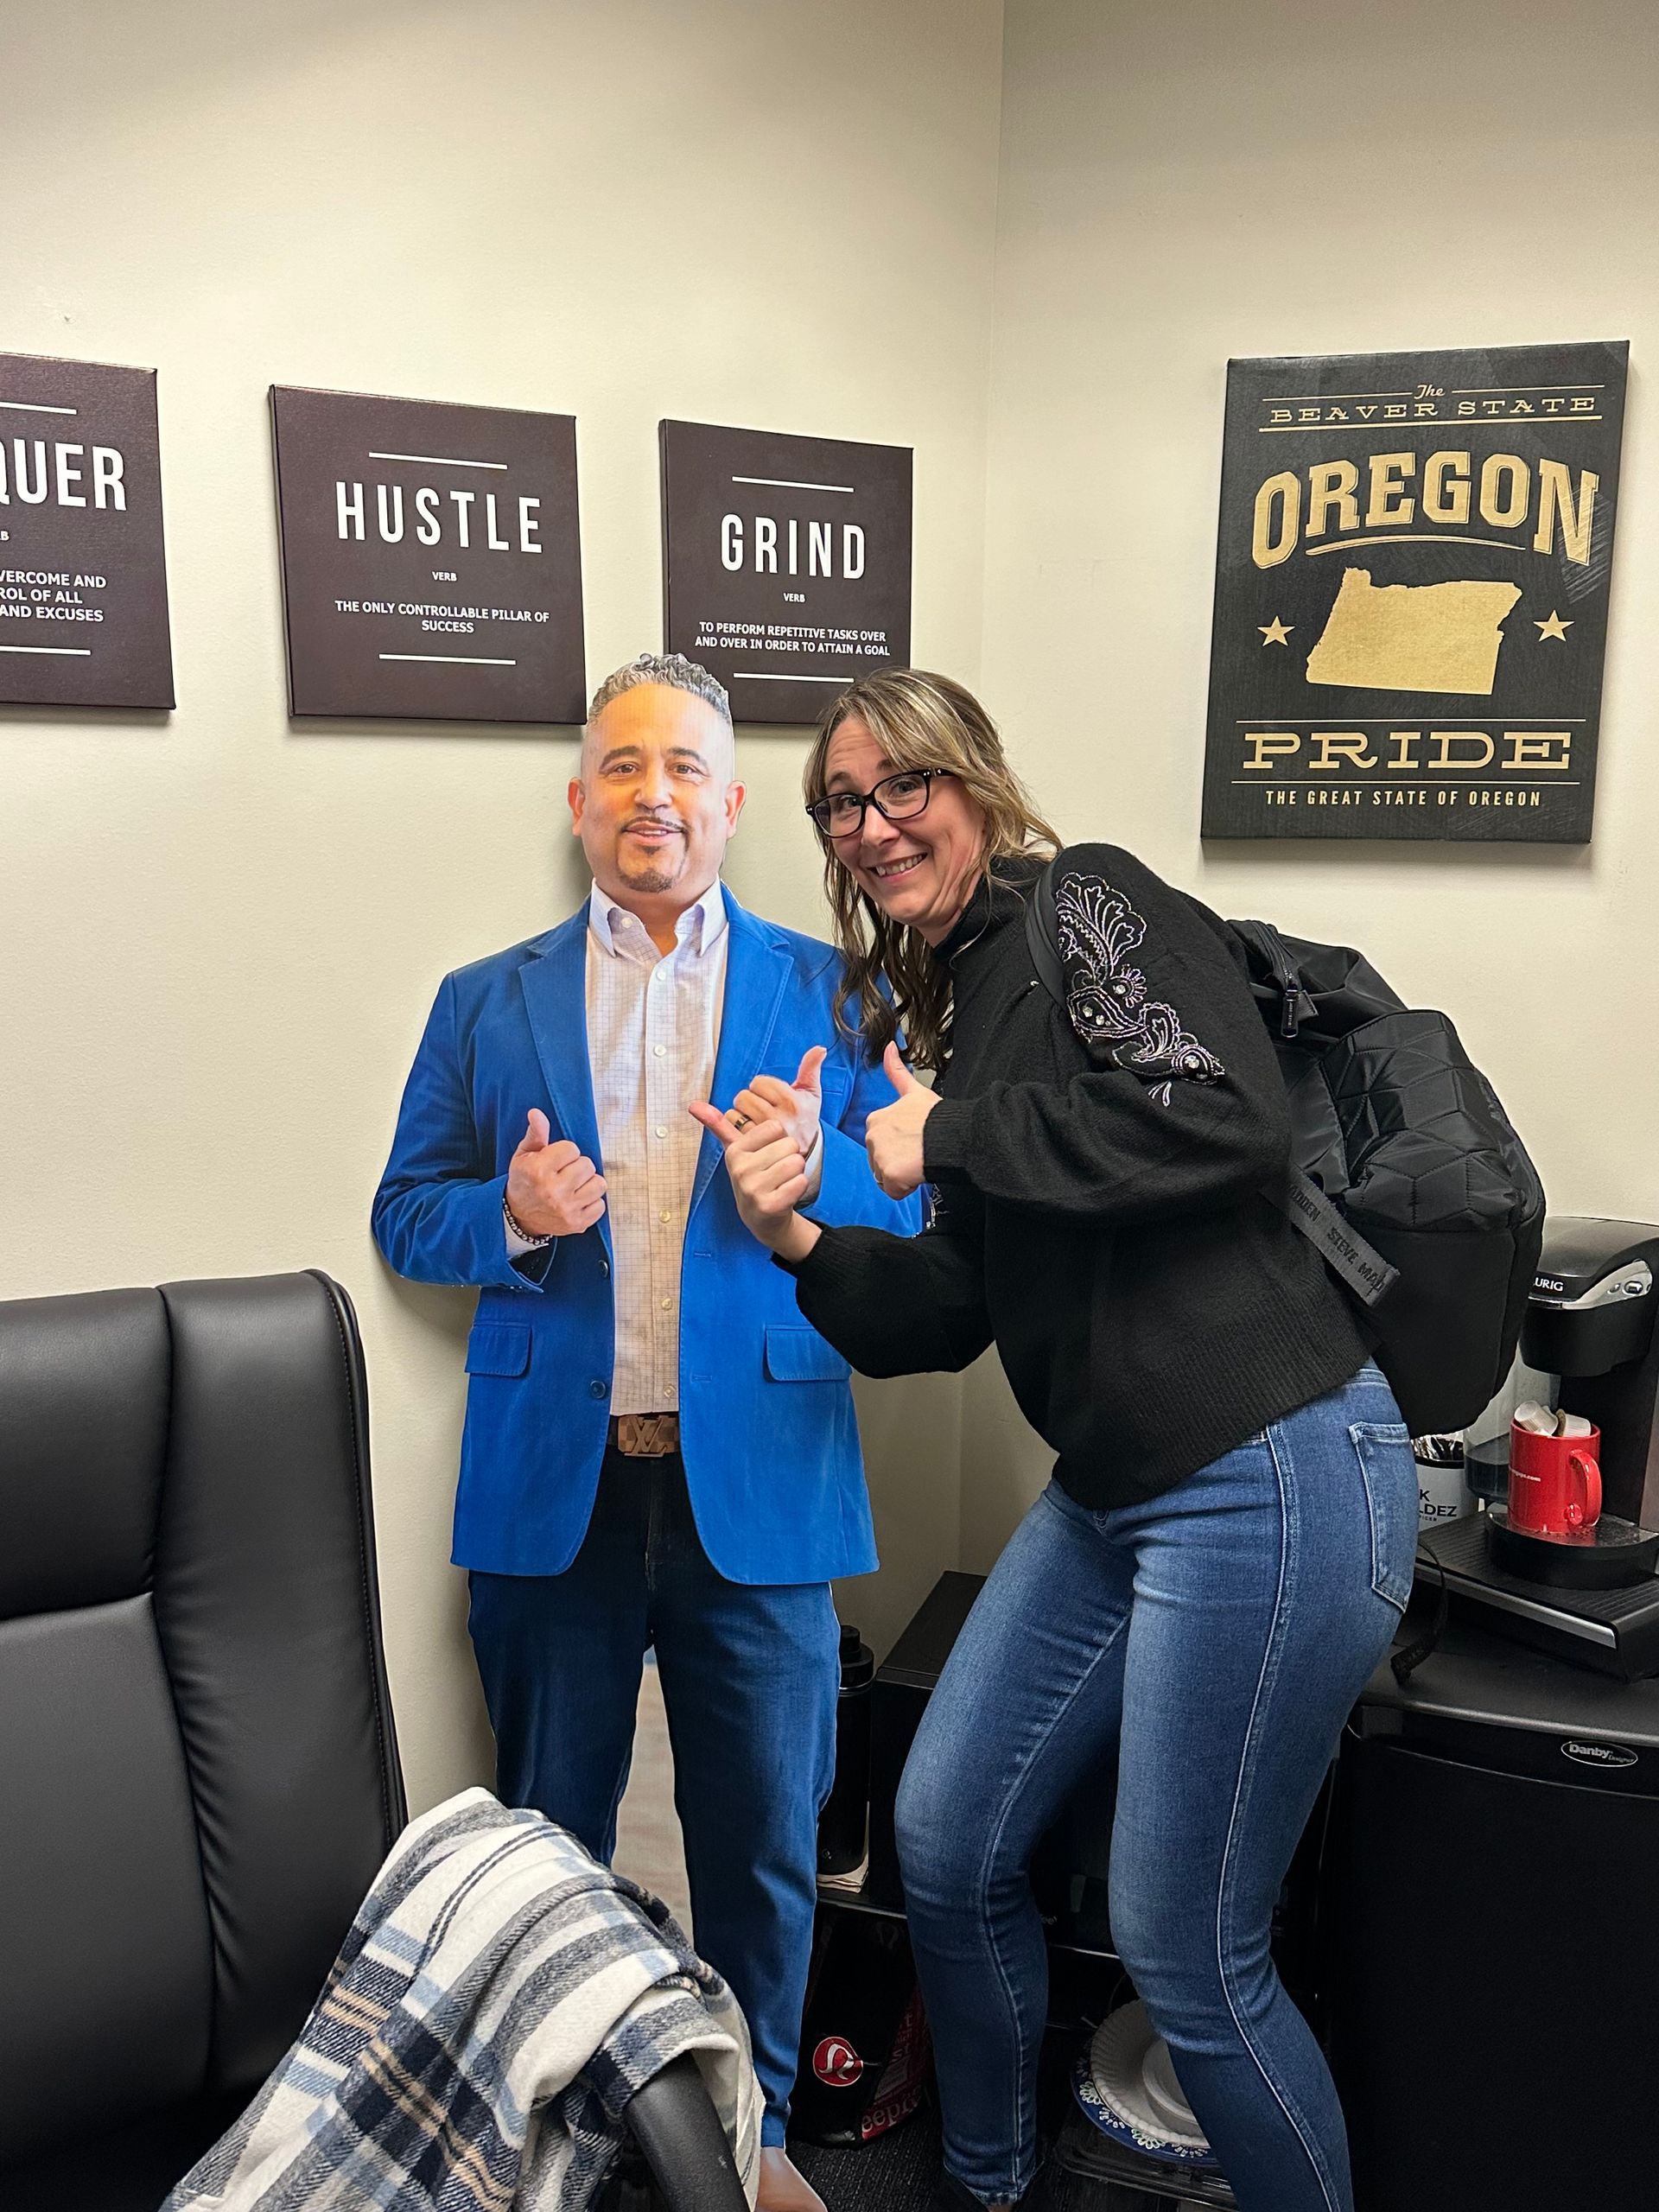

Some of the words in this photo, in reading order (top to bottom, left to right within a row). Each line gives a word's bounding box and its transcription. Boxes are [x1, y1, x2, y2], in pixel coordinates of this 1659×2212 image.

[1413, 385, 1446, 399] The
[1270, 403, 1439, 423] BEAVER
[1457, 397, 1596, 416] STATE
[0, 438, 127, 511] UER
[335, 480, 543, 554] HUSTLE
[1251, 449, 1599, 569] OREGON
[721, 513, 866, 580] GRIND
[73, 575, 107, 588] AND
[432, 571, 457, 582] VERB
[30, 588, 52, 602] OF
[54, 590, 84, 604] ALL
[783, 593, 806, 604] VERB
[0, 604, 32, 618] AND
[35, 606, 105, 622] EXCUSES
[334, 600, 360, 613] THE
[362, 601, 396, 614] ONLY
[397, 603, 489, 620] CONTROLLABLE
[491, 608, 532, 622] PILLAR
[534, 611, 550, 623] OF
[421, 620, 474, 633] SUCCESS
[699, 621, 715, 632] TO
[715, 622, 766, 635] PERFORM
[767, 625, 826, 639] REPETITIVE
[827, 629, 859, 641] TASKS
[860, 630, 887, 642] OVER
[695, 636, 718, 647] AND
[720, 637, 748, 649] OVER
[750, 639, 763, 650] IN
[765, 639, 800, 652] ORDER
[802, 641, 816, 652] TO
[817, 642, 854, 654] ATTAIN
[855, 644, 863, 655] A
[864, 645, 891, 657] GOAL
[1242, 730, 1572, 770] PRIDE
[1266, 790, 1297, 805] THE
[1306, 790, 1362, 805] GREAT
[1372, 790, 1427, 805] STATE
[1437, 791, 1459, 805] OF
[1469, 791, 1541, 806] OREGON
[1533, 1277, 1564, 1292] URIG
[1568, 1743, 1611, 1759] Danby
